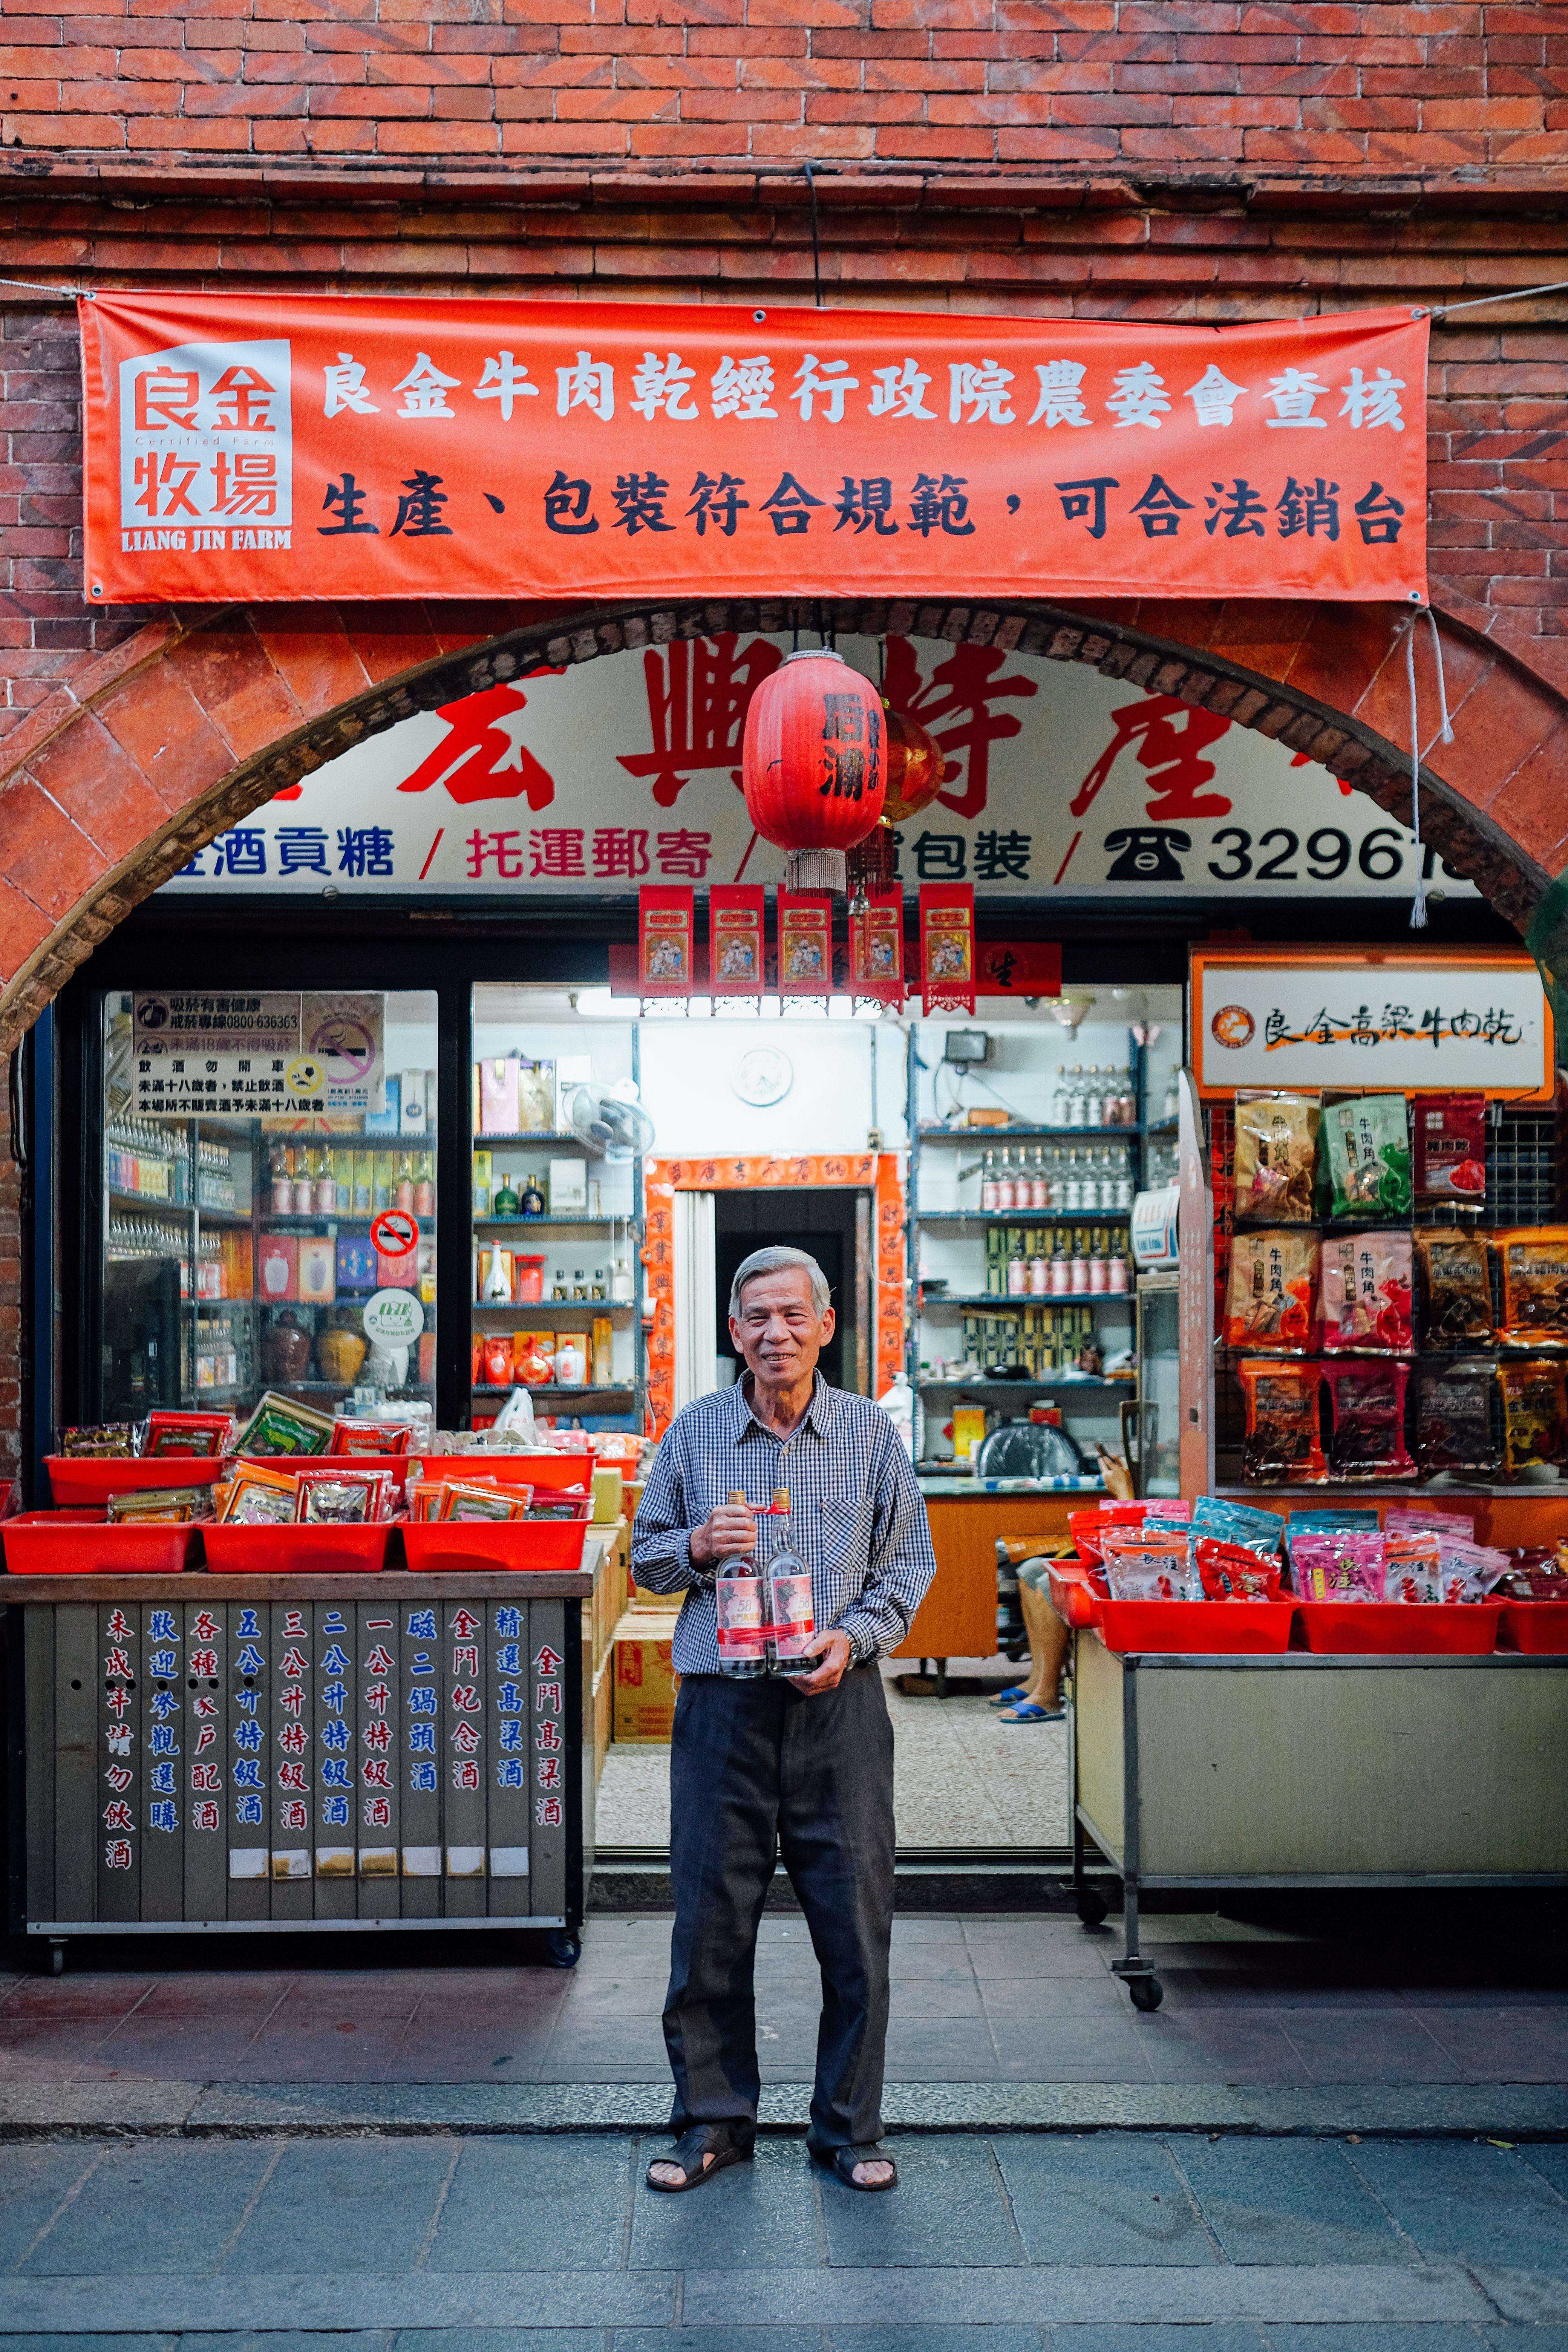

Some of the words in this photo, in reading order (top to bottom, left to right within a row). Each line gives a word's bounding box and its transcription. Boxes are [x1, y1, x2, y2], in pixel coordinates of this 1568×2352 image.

[134, 365, 278, 433] 良金
[322, 349, 1408, 432] 良金牛肉乾經行政院農委會查核
[135, 435, 224, 447] Certified
[232, 435, 274, 447] Farm
[133, 452, 277, 517] 牧場
[316, 468, 1407, 546] 生產、包裝符合規範，可合法銷台
[121, 530, 186, 553] LIANG
[190, 530, 226, 553] JIN
[231, 528, 292, 551] FARM
[466, 827, 713, 879] 托運郵寄
[737, 1599, 752, 1612] 58
[798, 1596, 810, 1609] 58
[277, 1610, 310, 1831] 三公升特級酒
[320, 1610, 354, 1827] 二公升特級酒
[361, 1615, 394, 1828] 一公升特級酒
[449, 1608, 482, 1791] 金門紀念酒
